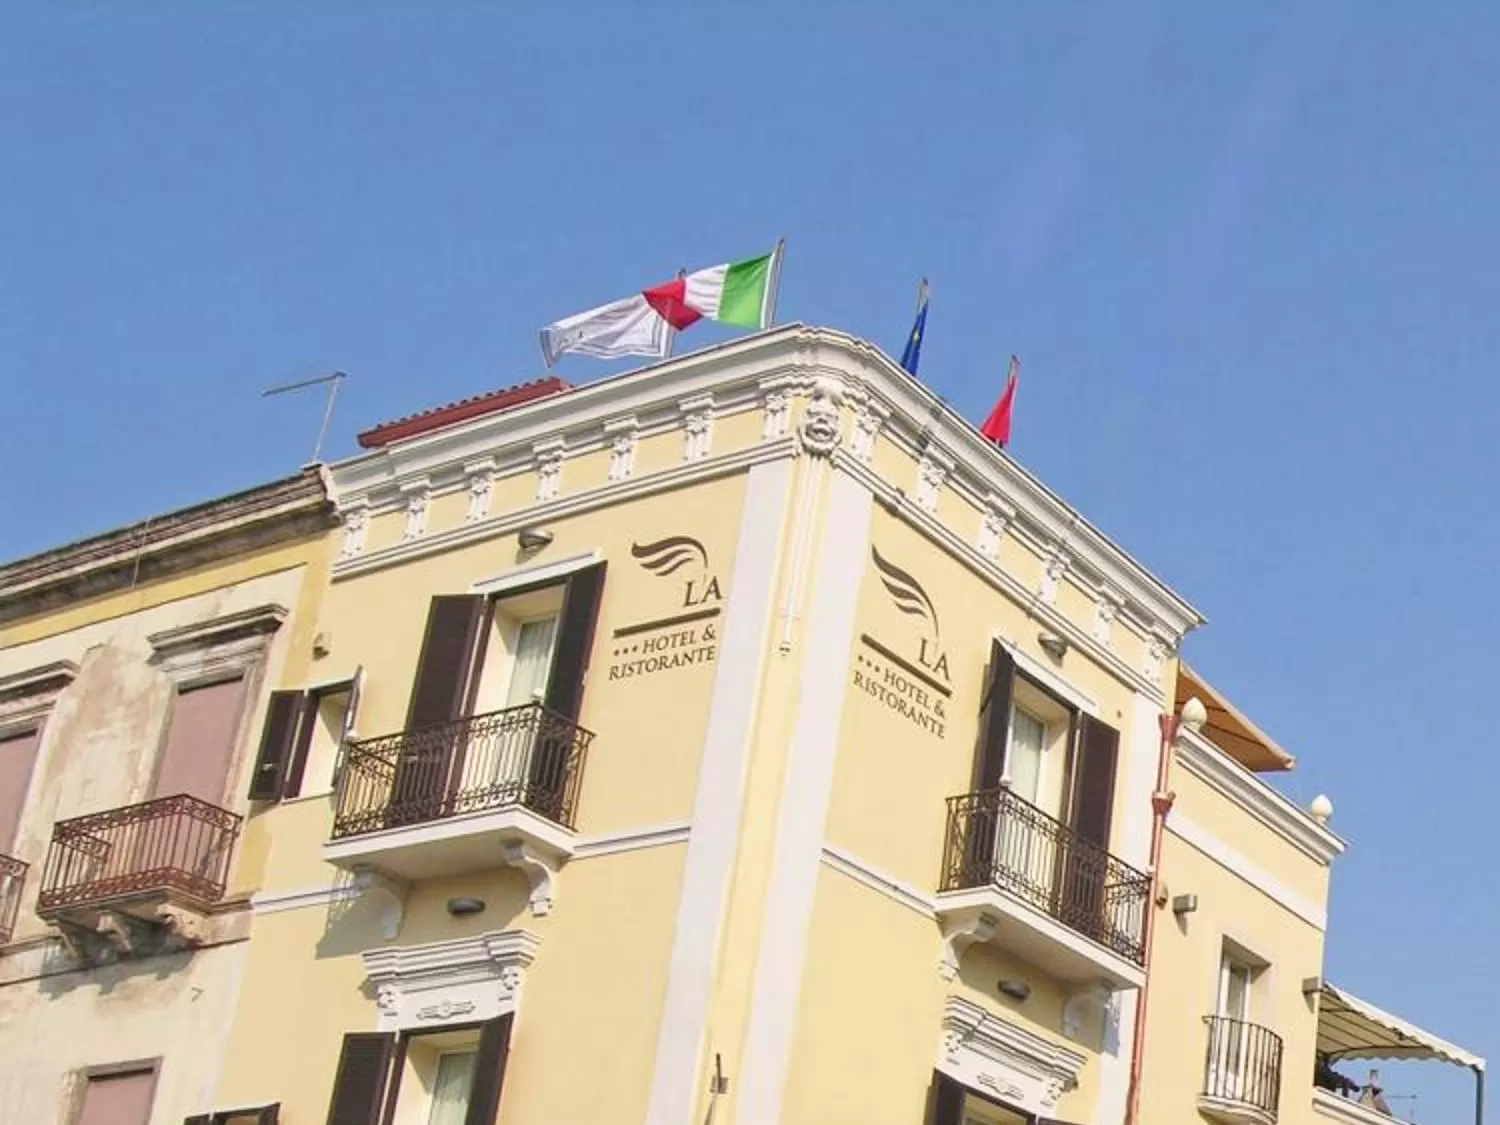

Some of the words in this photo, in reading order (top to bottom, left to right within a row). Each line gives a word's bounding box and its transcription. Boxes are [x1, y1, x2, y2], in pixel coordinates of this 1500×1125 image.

[643, 627, 697, 654] HOTEL
[701, 623, 717, 642] &
[608, 645, 716, 681] RISTORANTE
[852, 670, 946, 740] RISTORANTE
[884, 667, 932, 709] HOTEL
[933, 699, 946, 719] &
